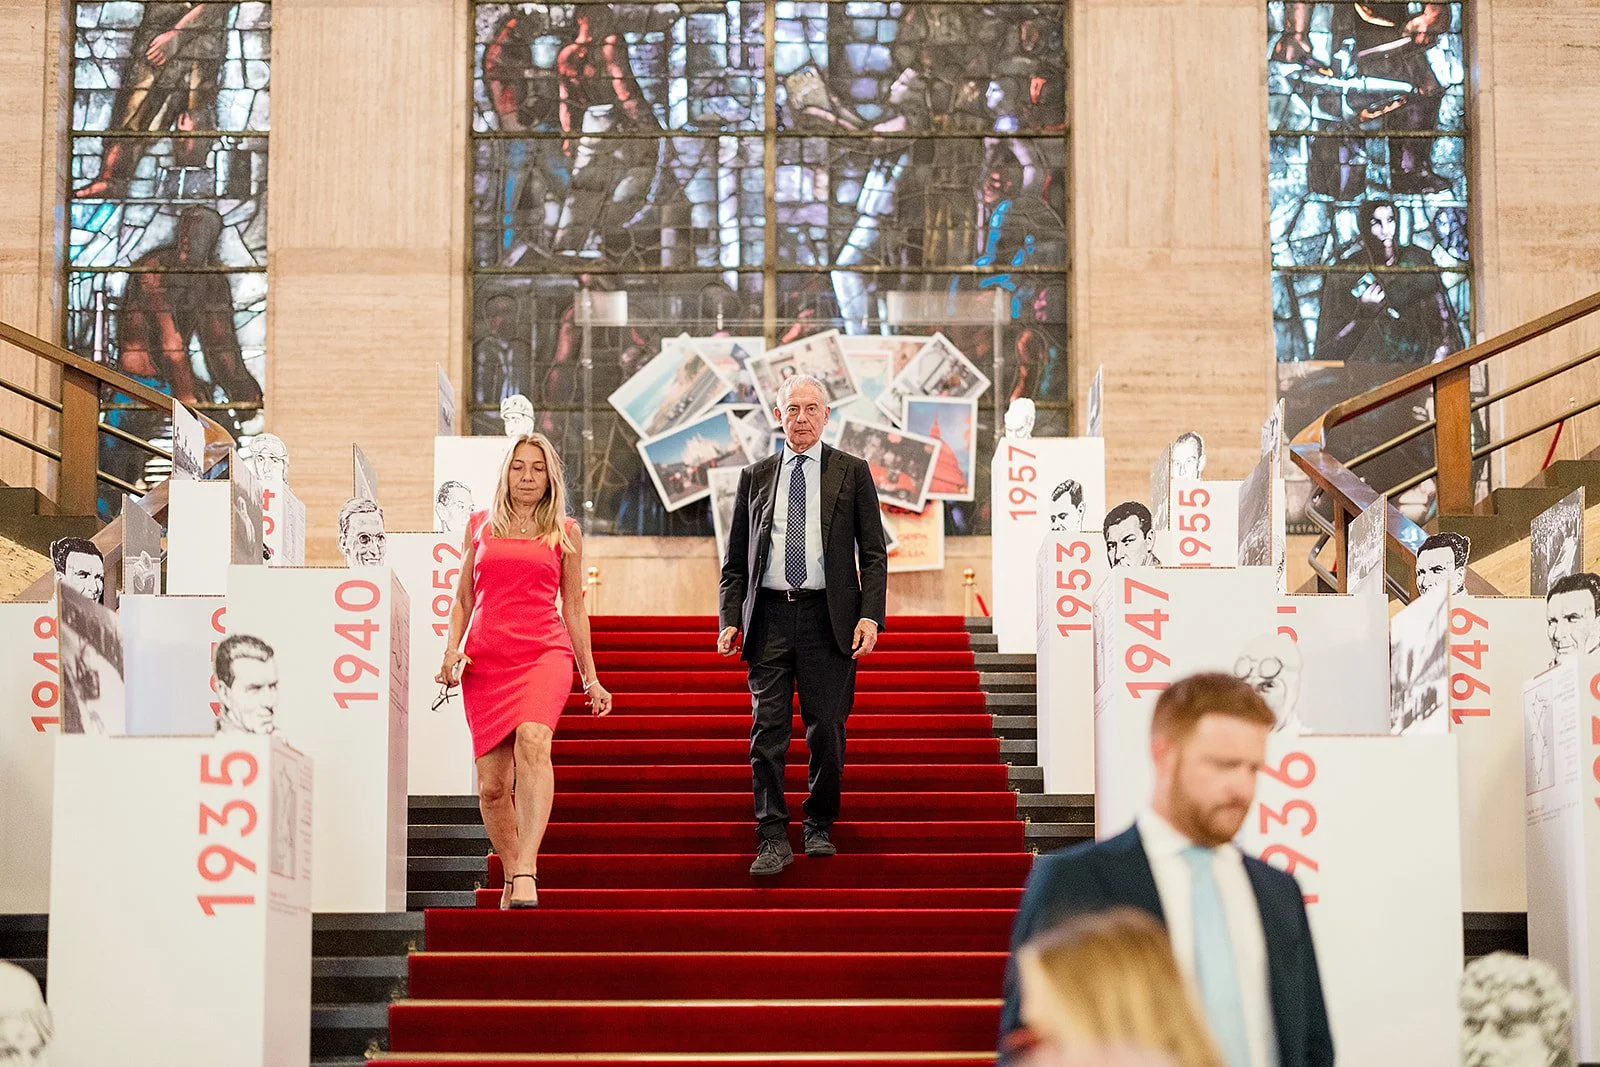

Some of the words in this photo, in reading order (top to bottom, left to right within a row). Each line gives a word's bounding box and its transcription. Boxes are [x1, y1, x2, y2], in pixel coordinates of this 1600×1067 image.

[1008, 445, 1037, 521] 1957
[333, 579, 381, 709] 1940
[432, 542, 463, 637] 1952
[1056, 541, 1092, 637] 1953
[1124, 577, 1171, 699] 1947
[1450, 607, 1491, 725] 1949
[197, 751, 259, 917] 1935
[1259, 751, 1319, 905] 936
